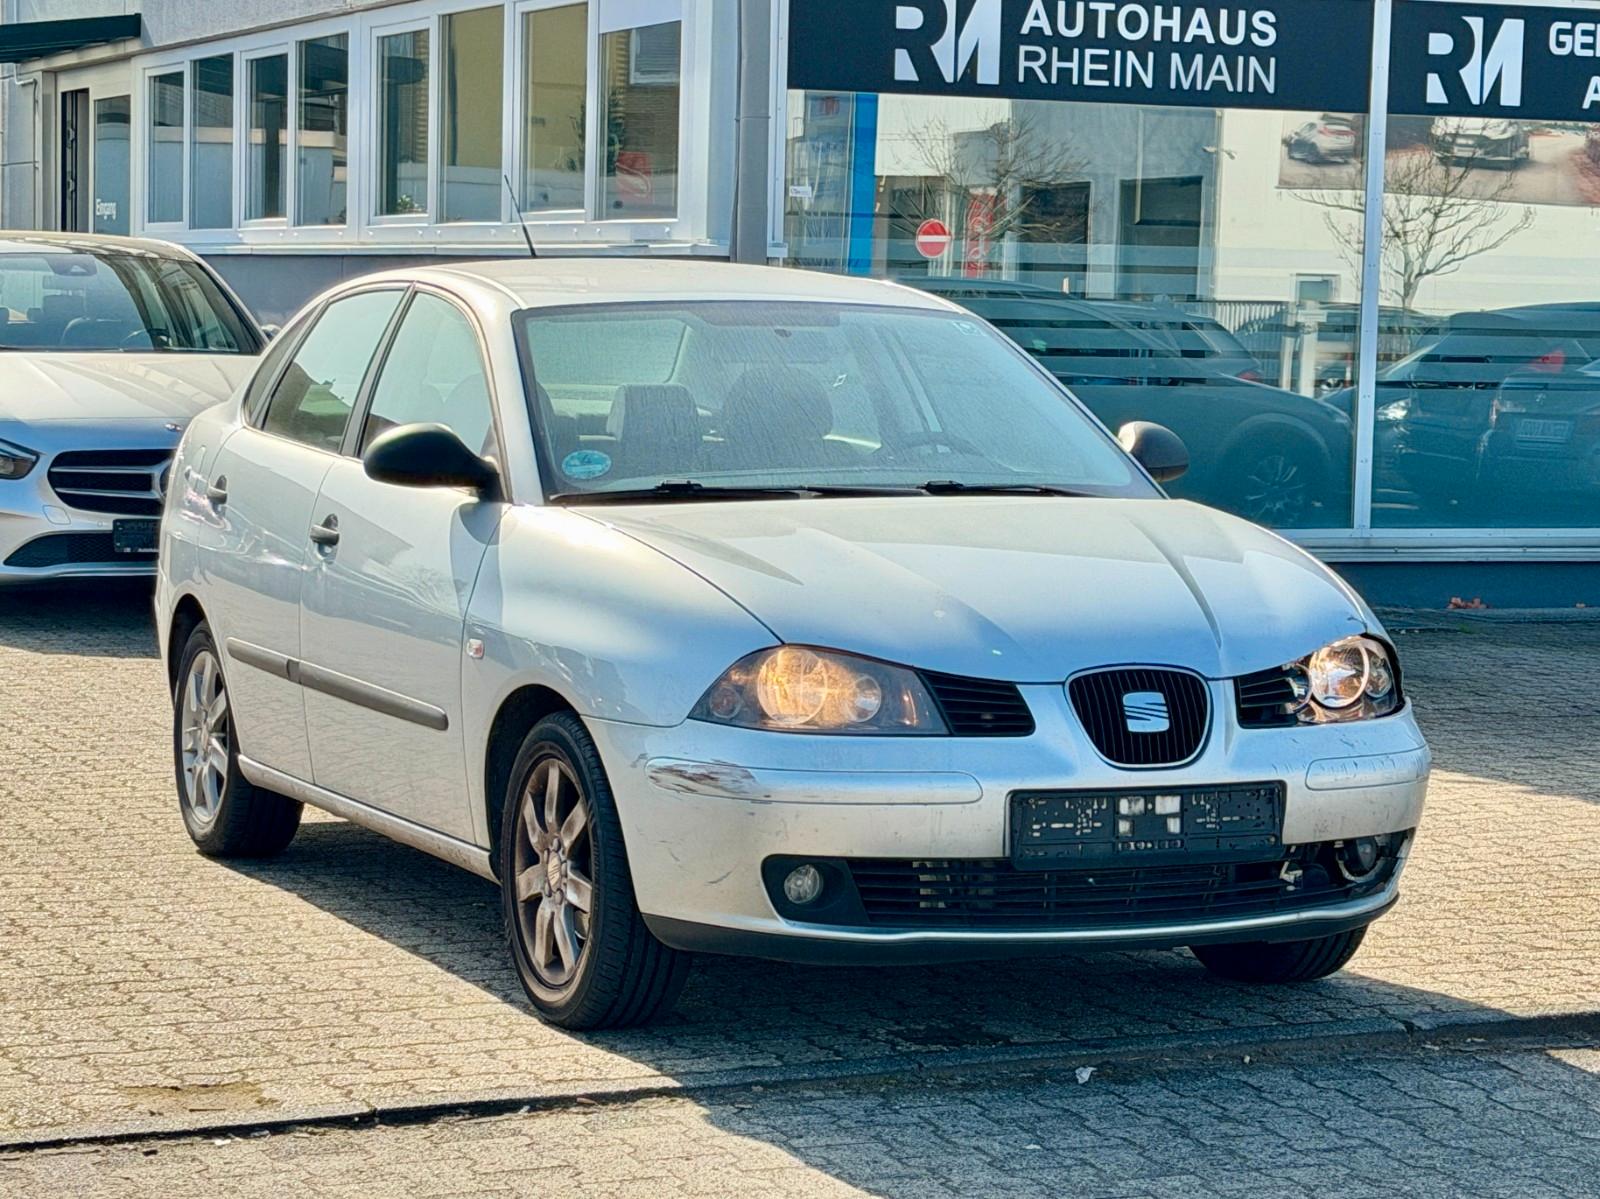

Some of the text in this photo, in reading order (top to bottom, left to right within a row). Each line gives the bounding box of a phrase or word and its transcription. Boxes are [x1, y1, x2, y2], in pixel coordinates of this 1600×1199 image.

[1020, 0, 1277, 46] AUTOHAUS
[1549, 21, 1600, 57] GE
[1018, 45, 1276, 94] RHEIN MAIN
